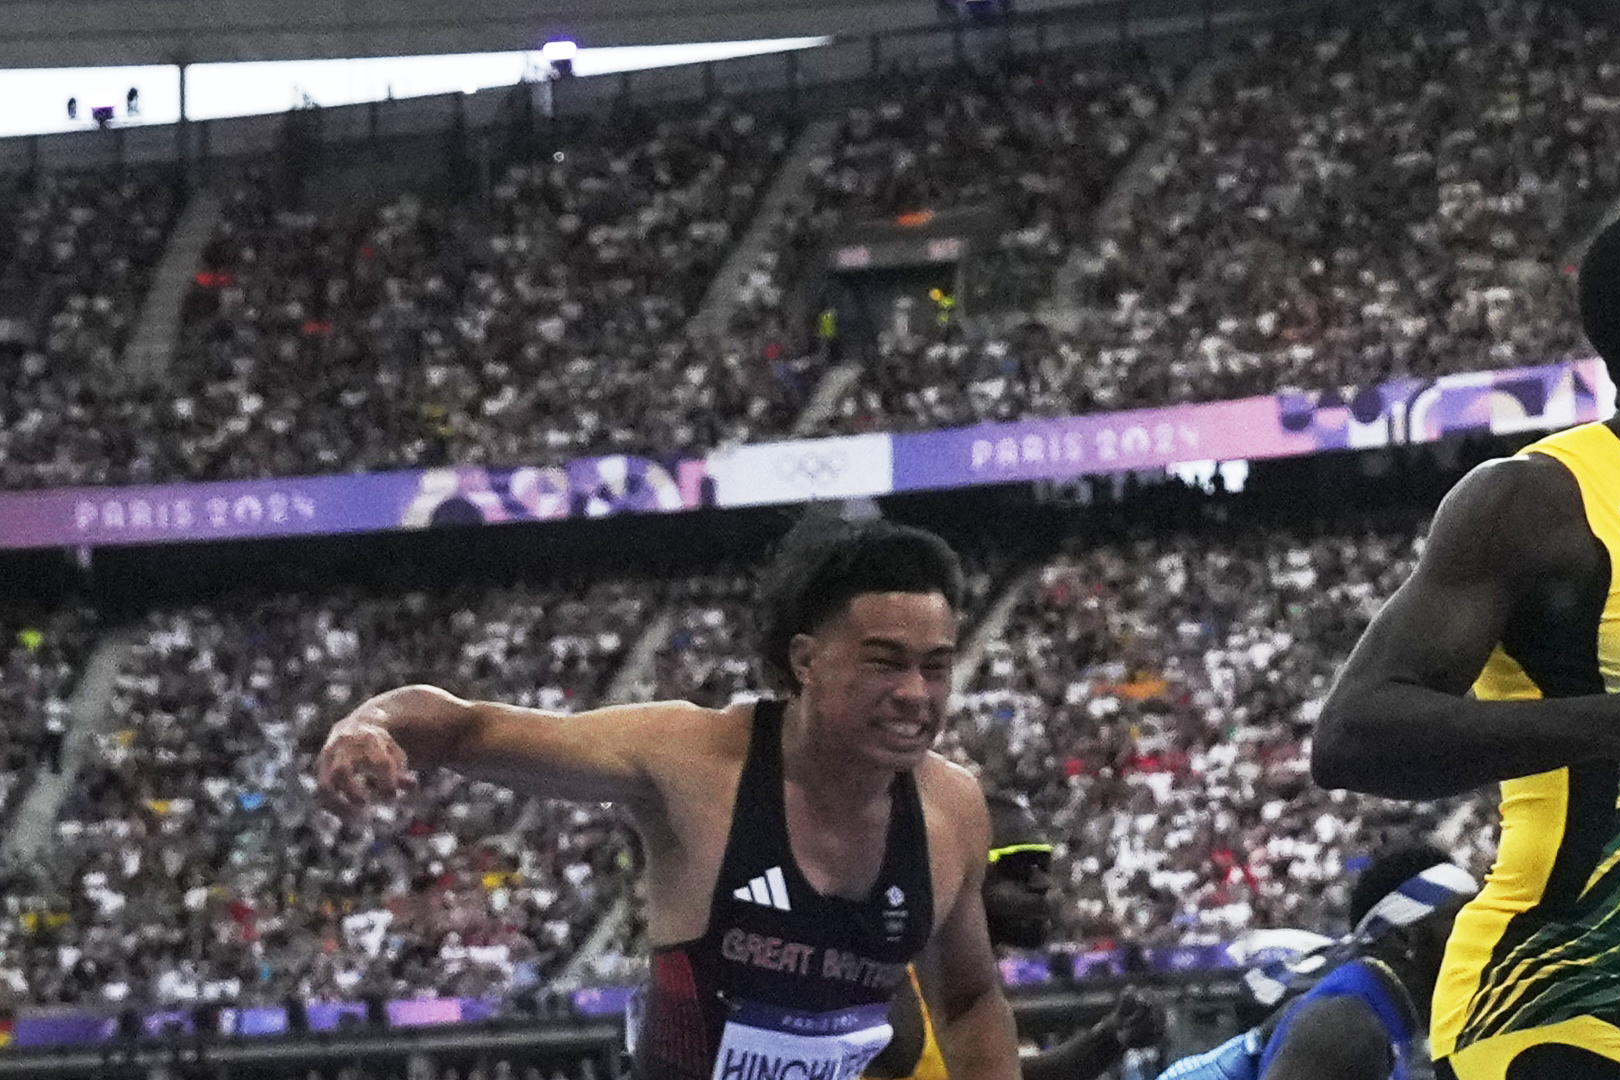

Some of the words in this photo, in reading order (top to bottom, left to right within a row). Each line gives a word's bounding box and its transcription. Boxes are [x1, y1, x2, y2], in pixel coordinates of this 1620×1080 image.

[971, 434, 1082, 469] PARIS
[1096, 422, 1199, 461] 2024
[75, 499, 193, 531] PARIS
[206, 491, 315, 527] 2024
[721, 927, 816, 976] GREAT
